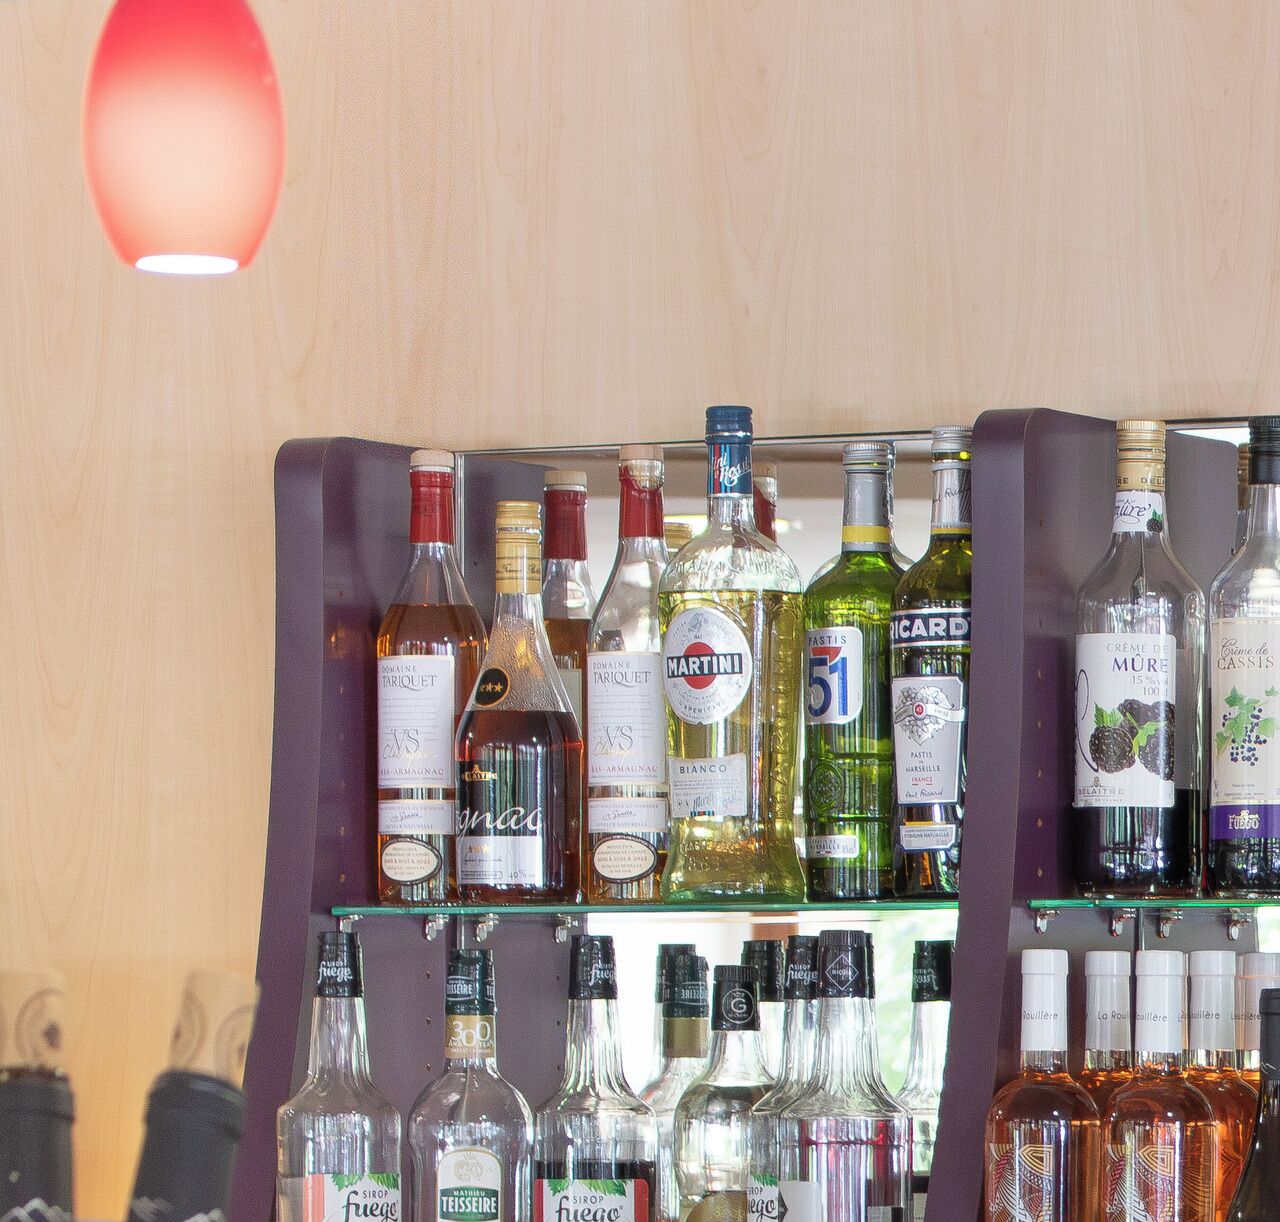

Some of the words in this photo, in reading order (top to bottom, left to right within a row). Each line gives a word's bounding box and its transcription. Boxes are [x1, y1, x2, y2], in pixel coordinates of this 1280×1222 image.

[807, 635, 848, 646] PASTIS
[668, 654, 742, 676] MARTINI
[1112, 653, 1169, 674] MÛRE
[1217, 656, 1275, 671] CASSIS
[593, 671, 651, 688] TARIQUET
[807, 655, 848, 718] 51
[1132, 675, 1143, 685] 15
[390, 728, 420, 753] VS
[602, 725, 634, 750] VS
[910, 751, 933, 759] PASTIS
[679, 764, 728, 775] BIANCO
[905, 765, 941, 773] MARSEILLE
[362, 1189, 389, 1199] SIROP
[572, 1195, 605, 1204] SIROP
[441, 1196, 497, 1214] TEISSEIRE
